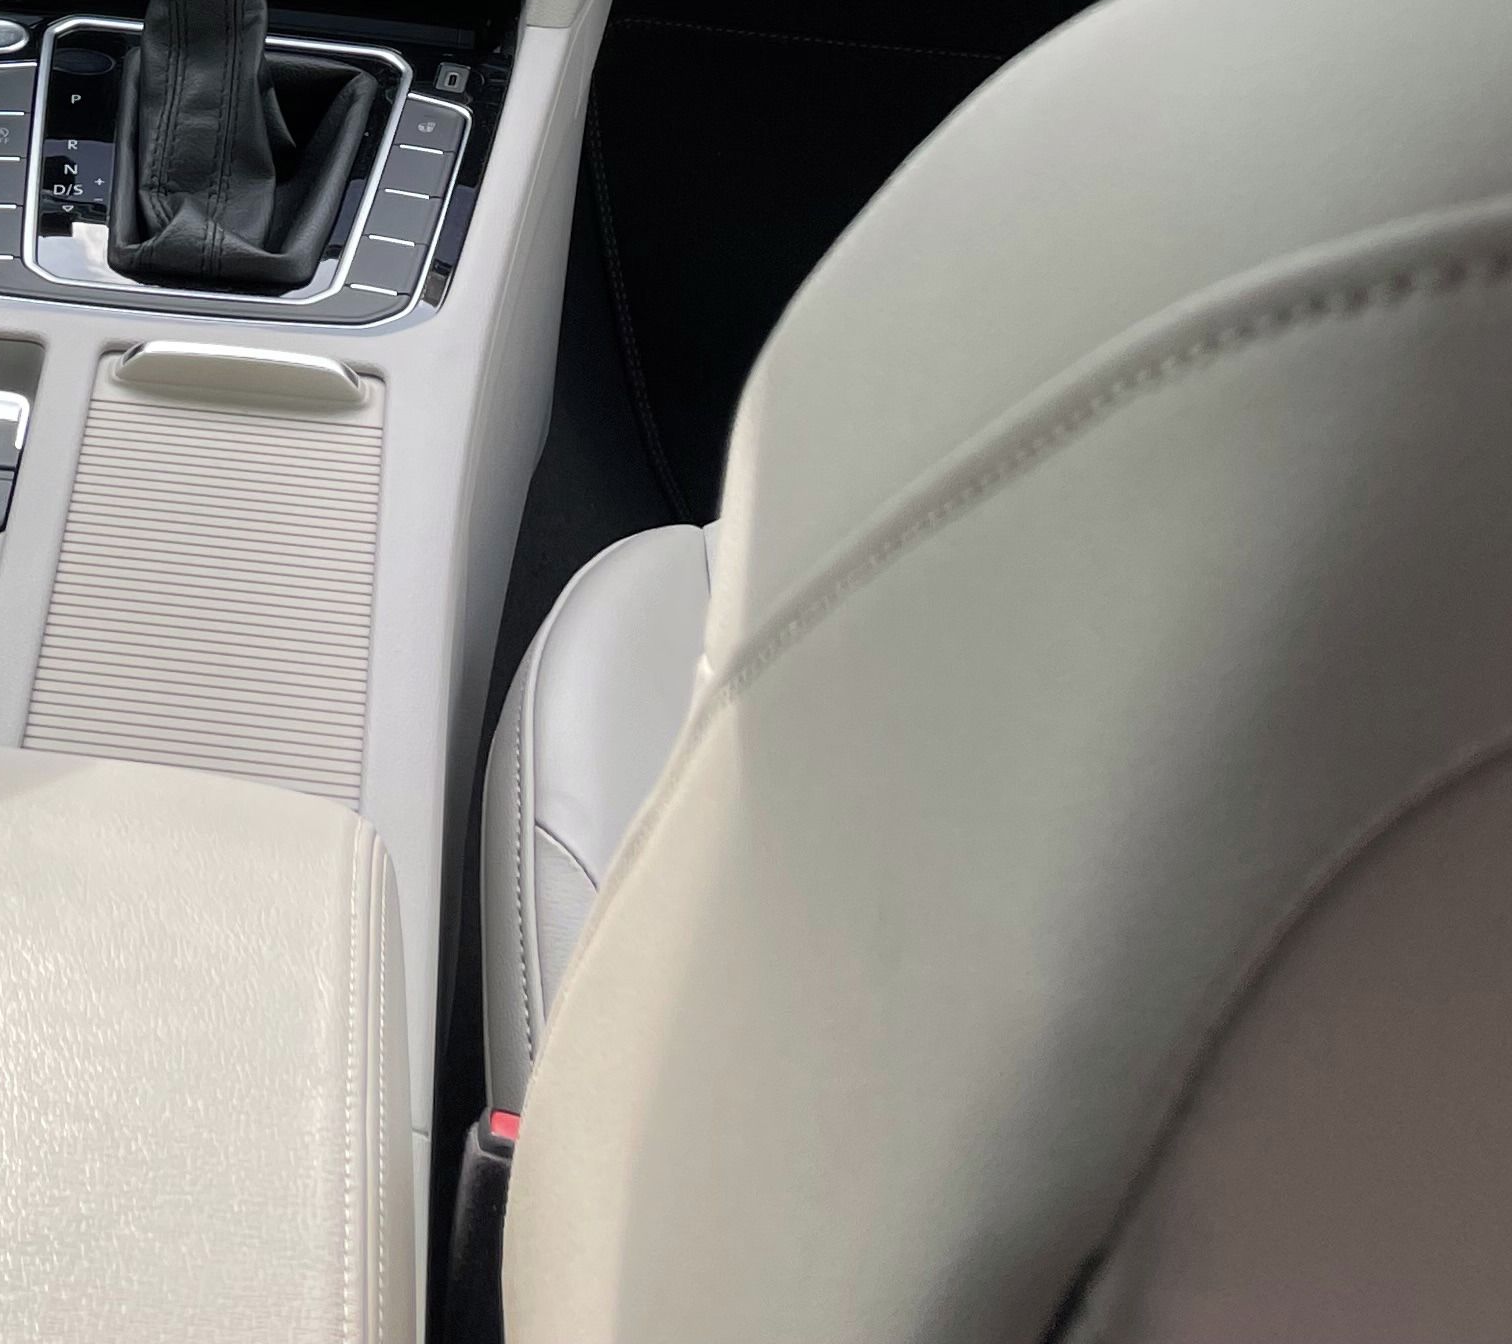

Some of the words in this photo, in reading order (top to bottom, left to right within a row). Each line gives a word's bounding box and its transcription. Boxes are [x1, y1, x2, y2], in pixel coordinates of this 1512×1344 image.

[71, 94, 82, 104] P
[68, 139, 79, 150] R
[64, 164, 78, 175] N
[53, 184, 84, 196] D/S
